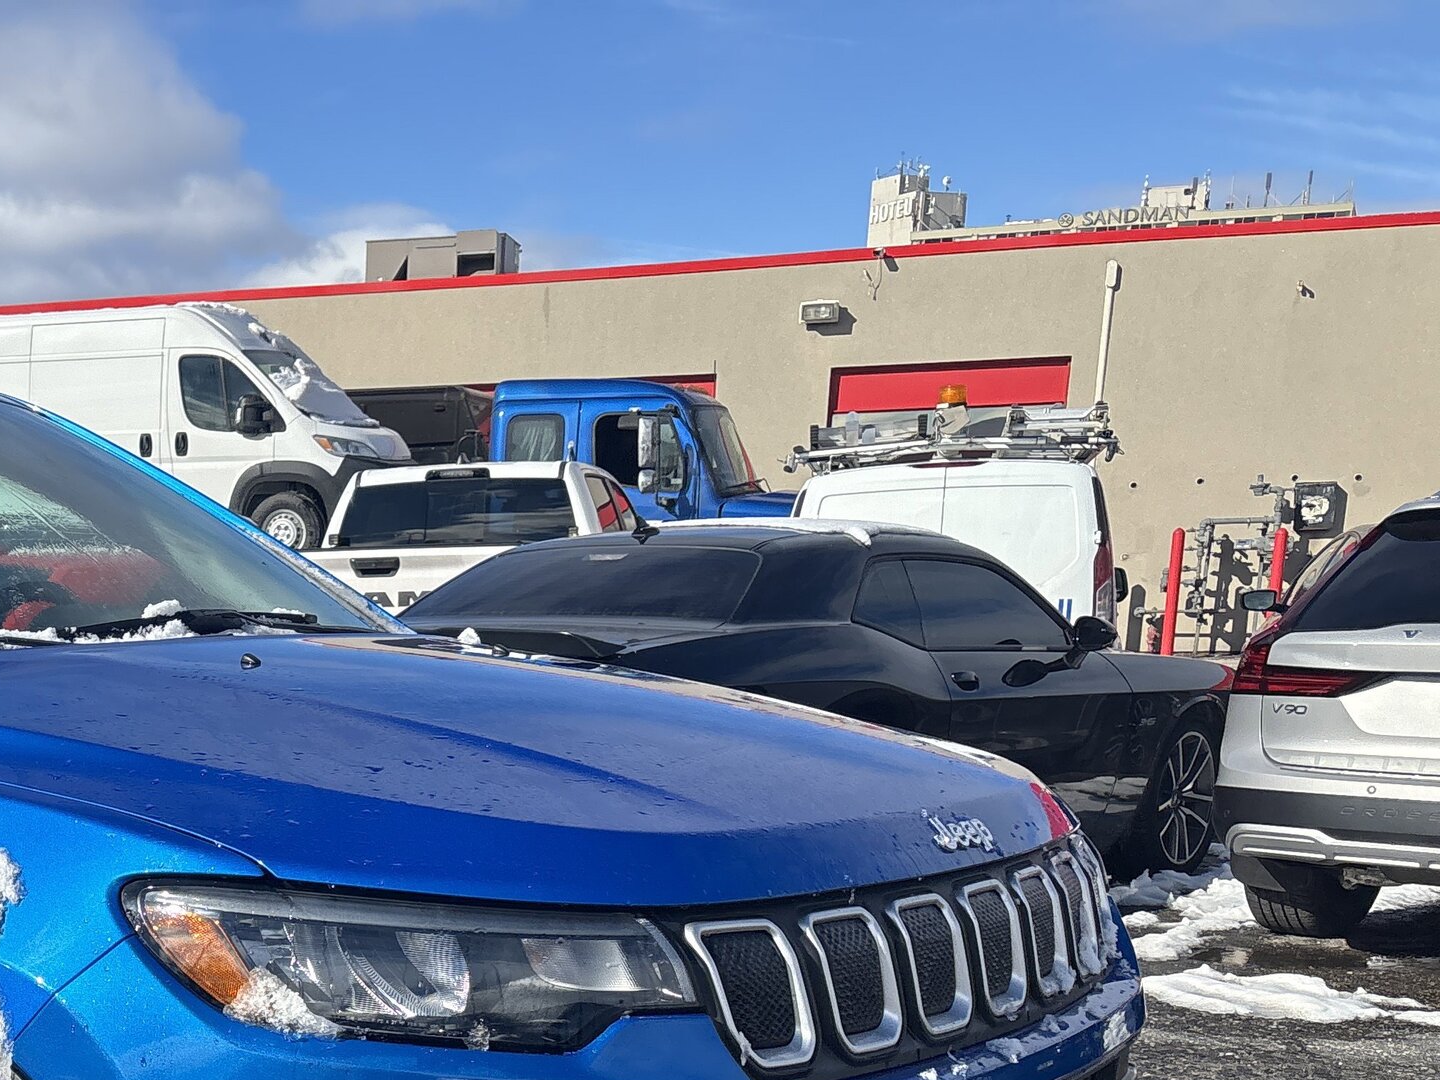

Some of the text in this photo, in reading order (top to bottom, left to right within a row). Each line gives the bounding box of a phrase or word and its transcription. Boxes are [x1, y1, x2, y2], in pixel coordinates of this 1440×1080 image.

[870, 197, 913, 224] HOTEL
[1082, 206, 1189, 226] SANDMAN
[364, 591, 432, 607] AM
[1272, 703, 1308, 715] V90
[927, 814, 994, 852] Jeep
